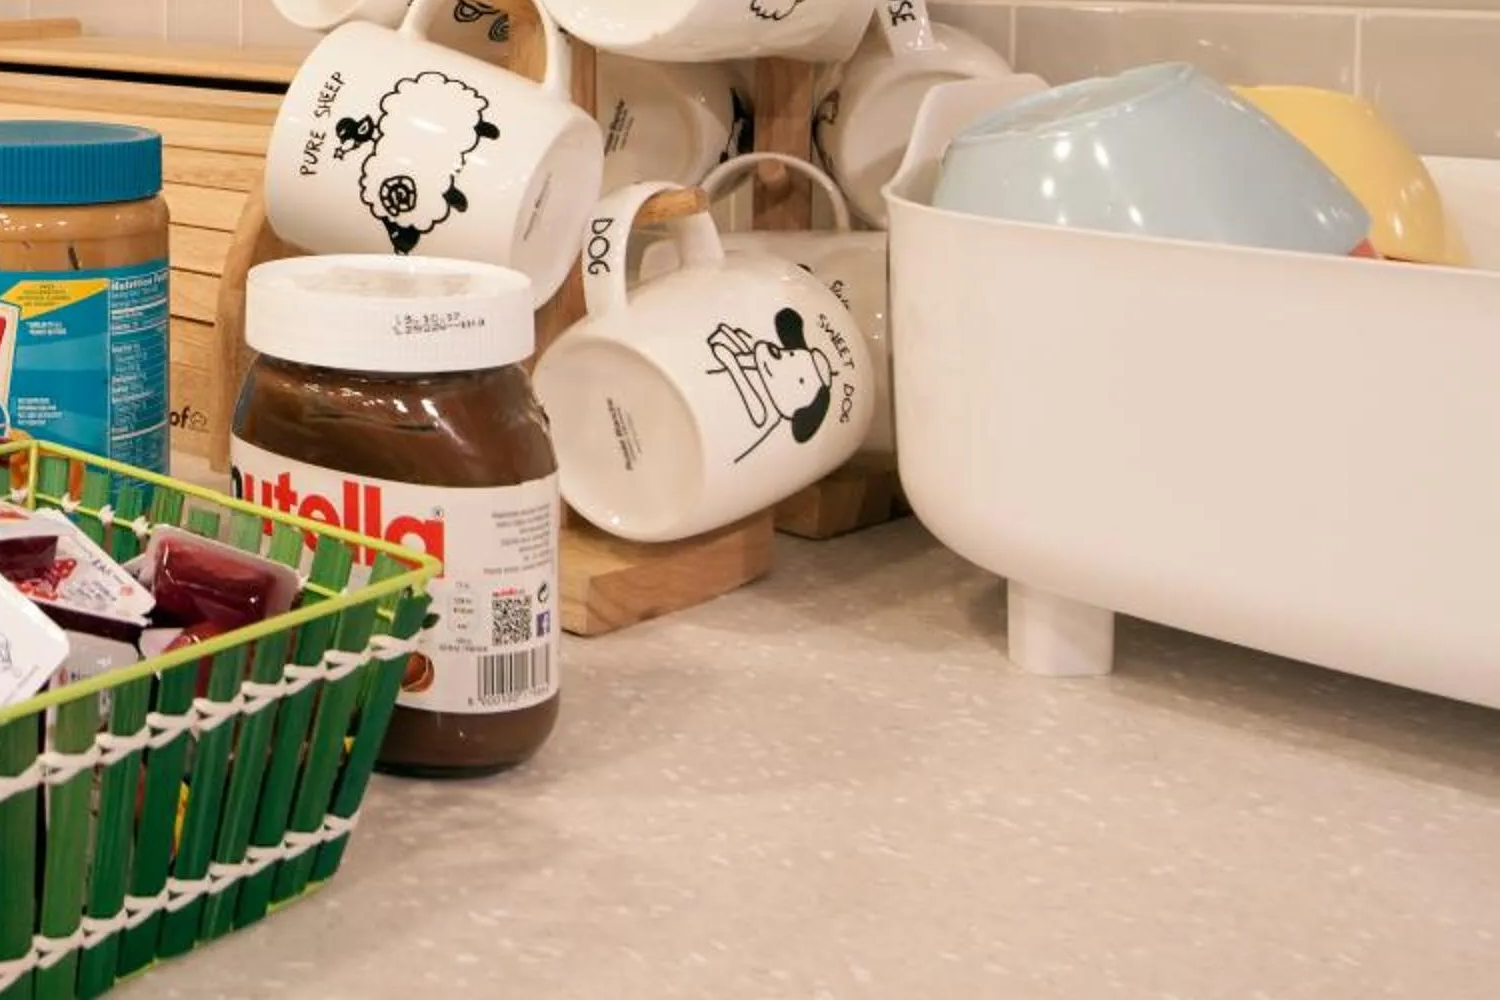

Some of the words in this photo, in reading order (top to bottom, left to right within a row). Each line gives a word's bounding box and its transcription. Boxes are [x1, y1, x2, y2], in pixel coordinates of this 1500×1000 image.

[300, 130, 327, 176] PURE
[314, 71, 346, 118] SHEEP
[587, 217, 614, 276] DOG
[817, 312, 856, 371] SWEET
[839, 382, 856, 425] DOG
